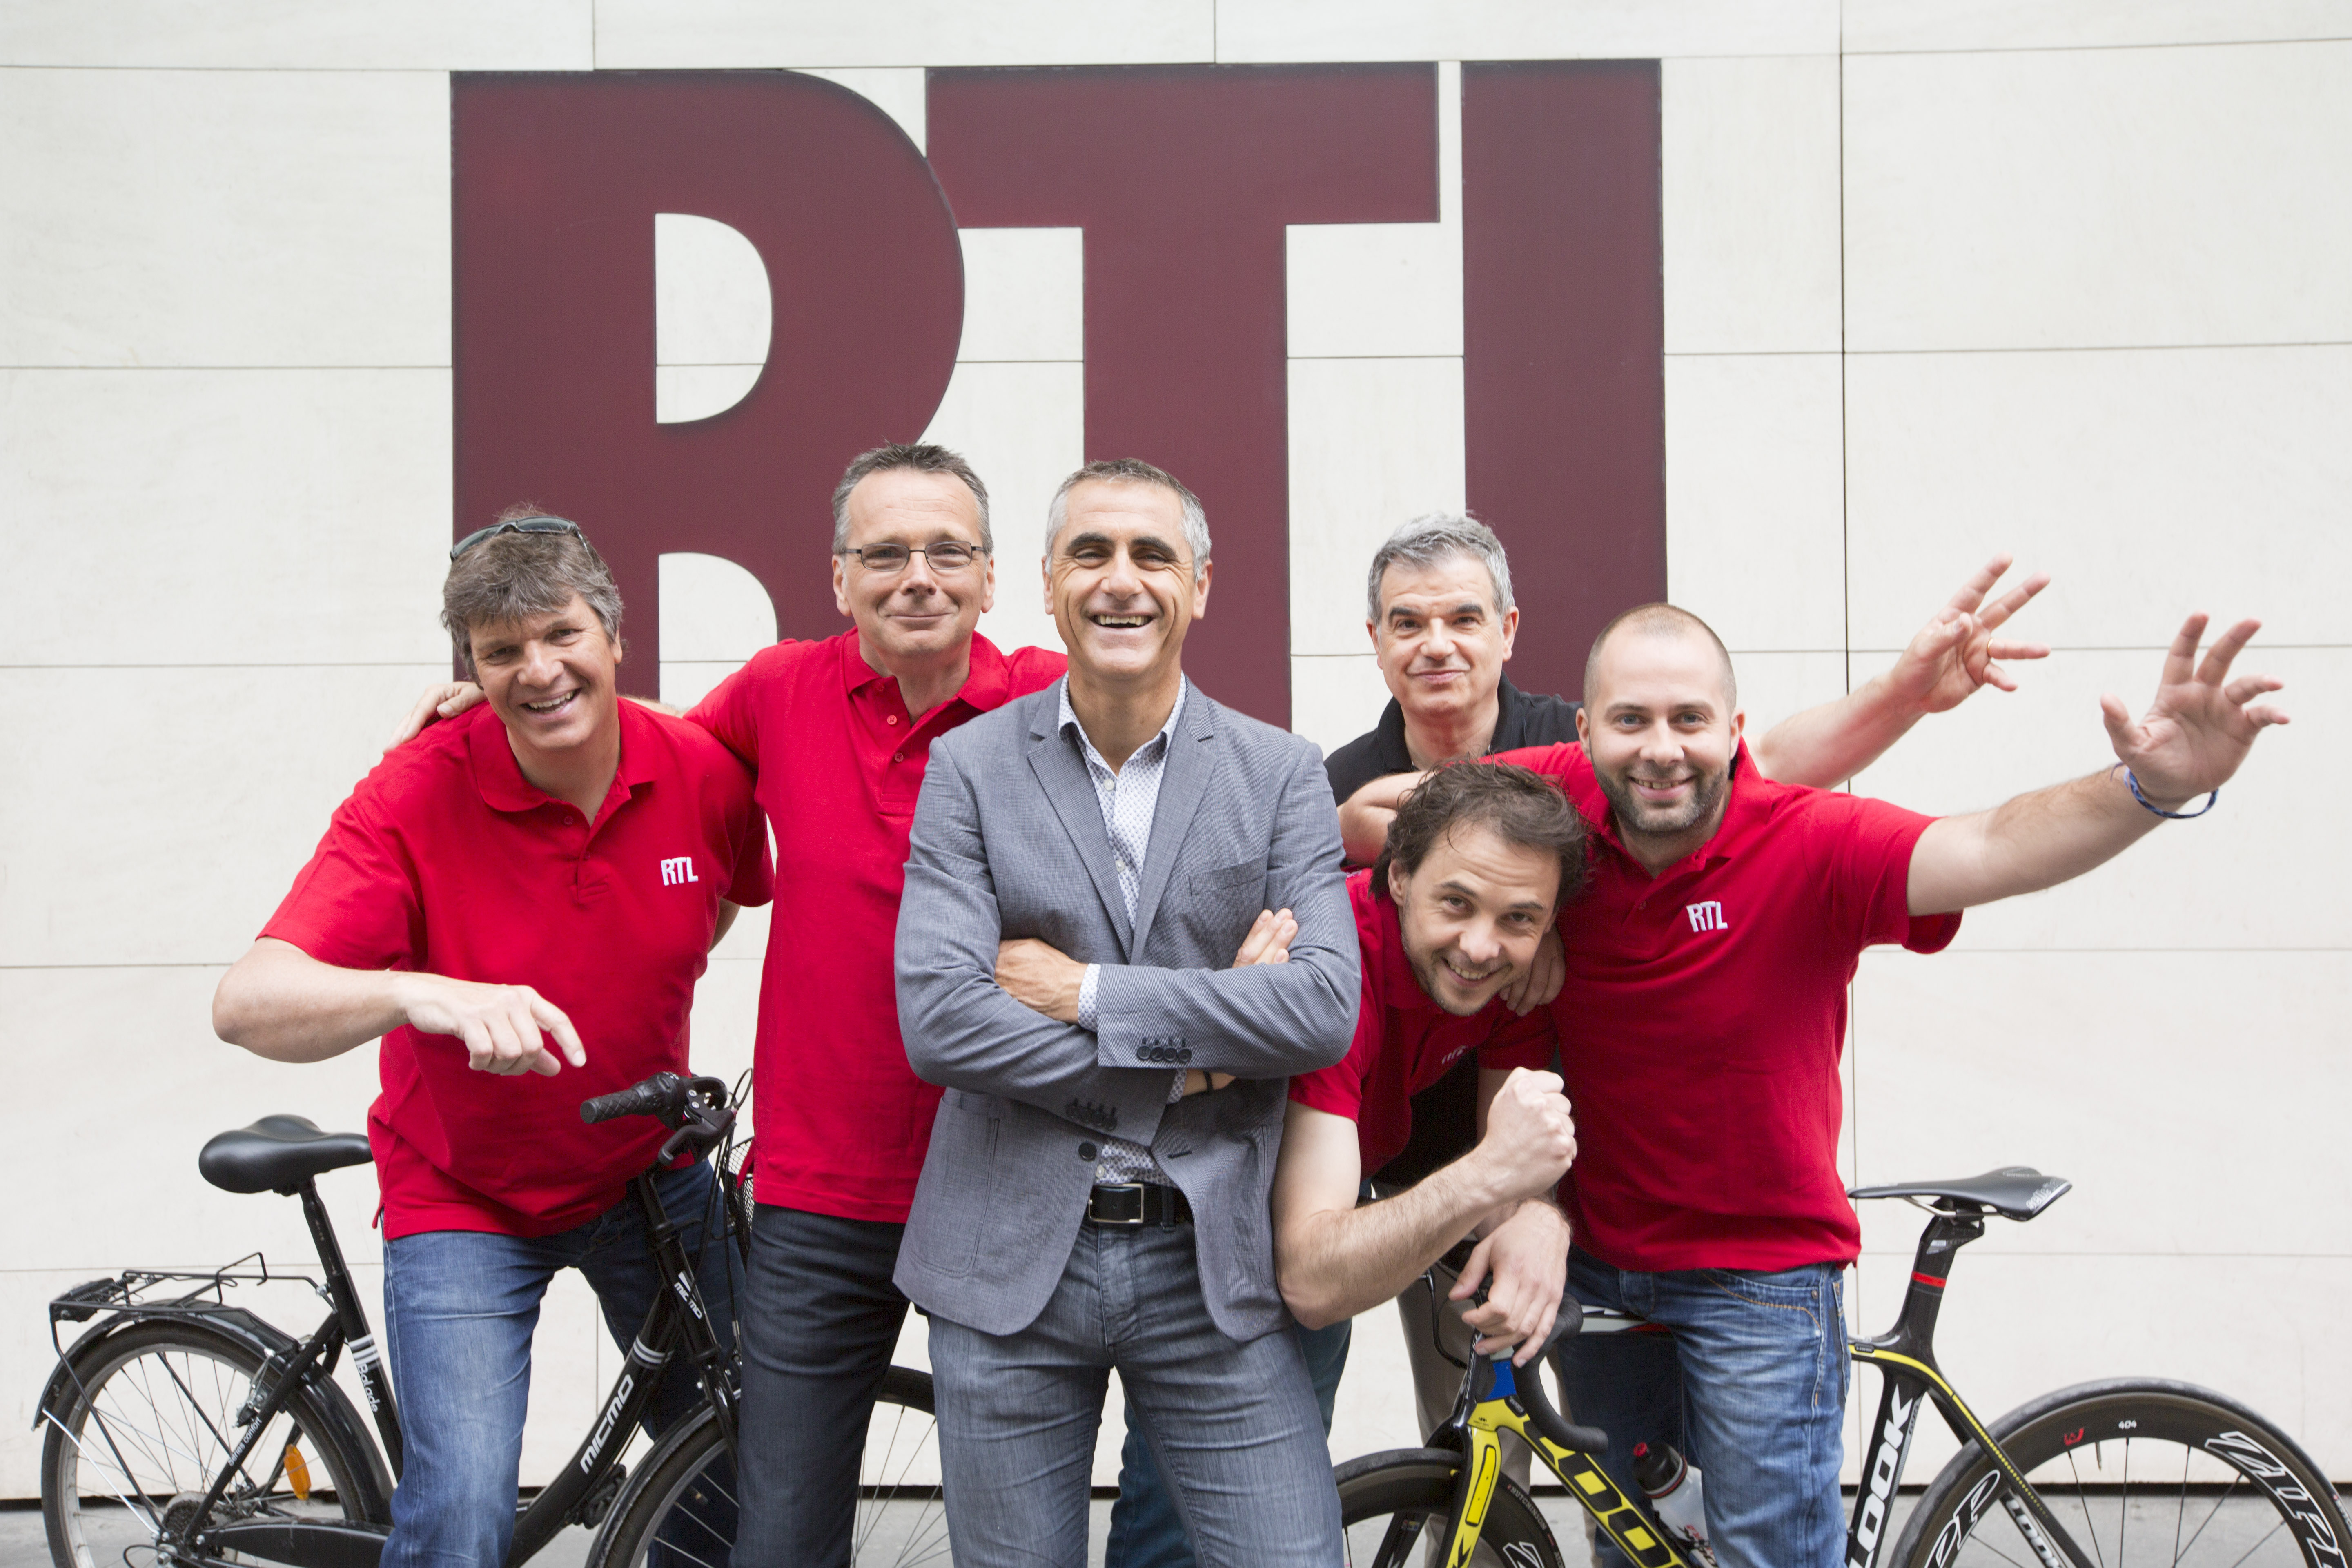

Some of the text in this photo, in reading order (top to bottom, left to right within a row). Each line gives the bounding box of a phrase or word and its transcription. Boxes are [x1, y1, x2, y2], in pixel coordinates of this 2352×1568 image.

[450, 58, 1668, 734] RTL
[661, 857, 699, 886] RTL
[1686, 901, 1728, 933] RTL
[356, 1363, 381, 1413] Balade
[580, 1374, 634, 1474] MICMO
[2118, 1419, 2137, 1430] 404
[1510, 1487, 1548, 1530] HUTCHINSON
[1523, 1419, 1686, 1568] LOO
